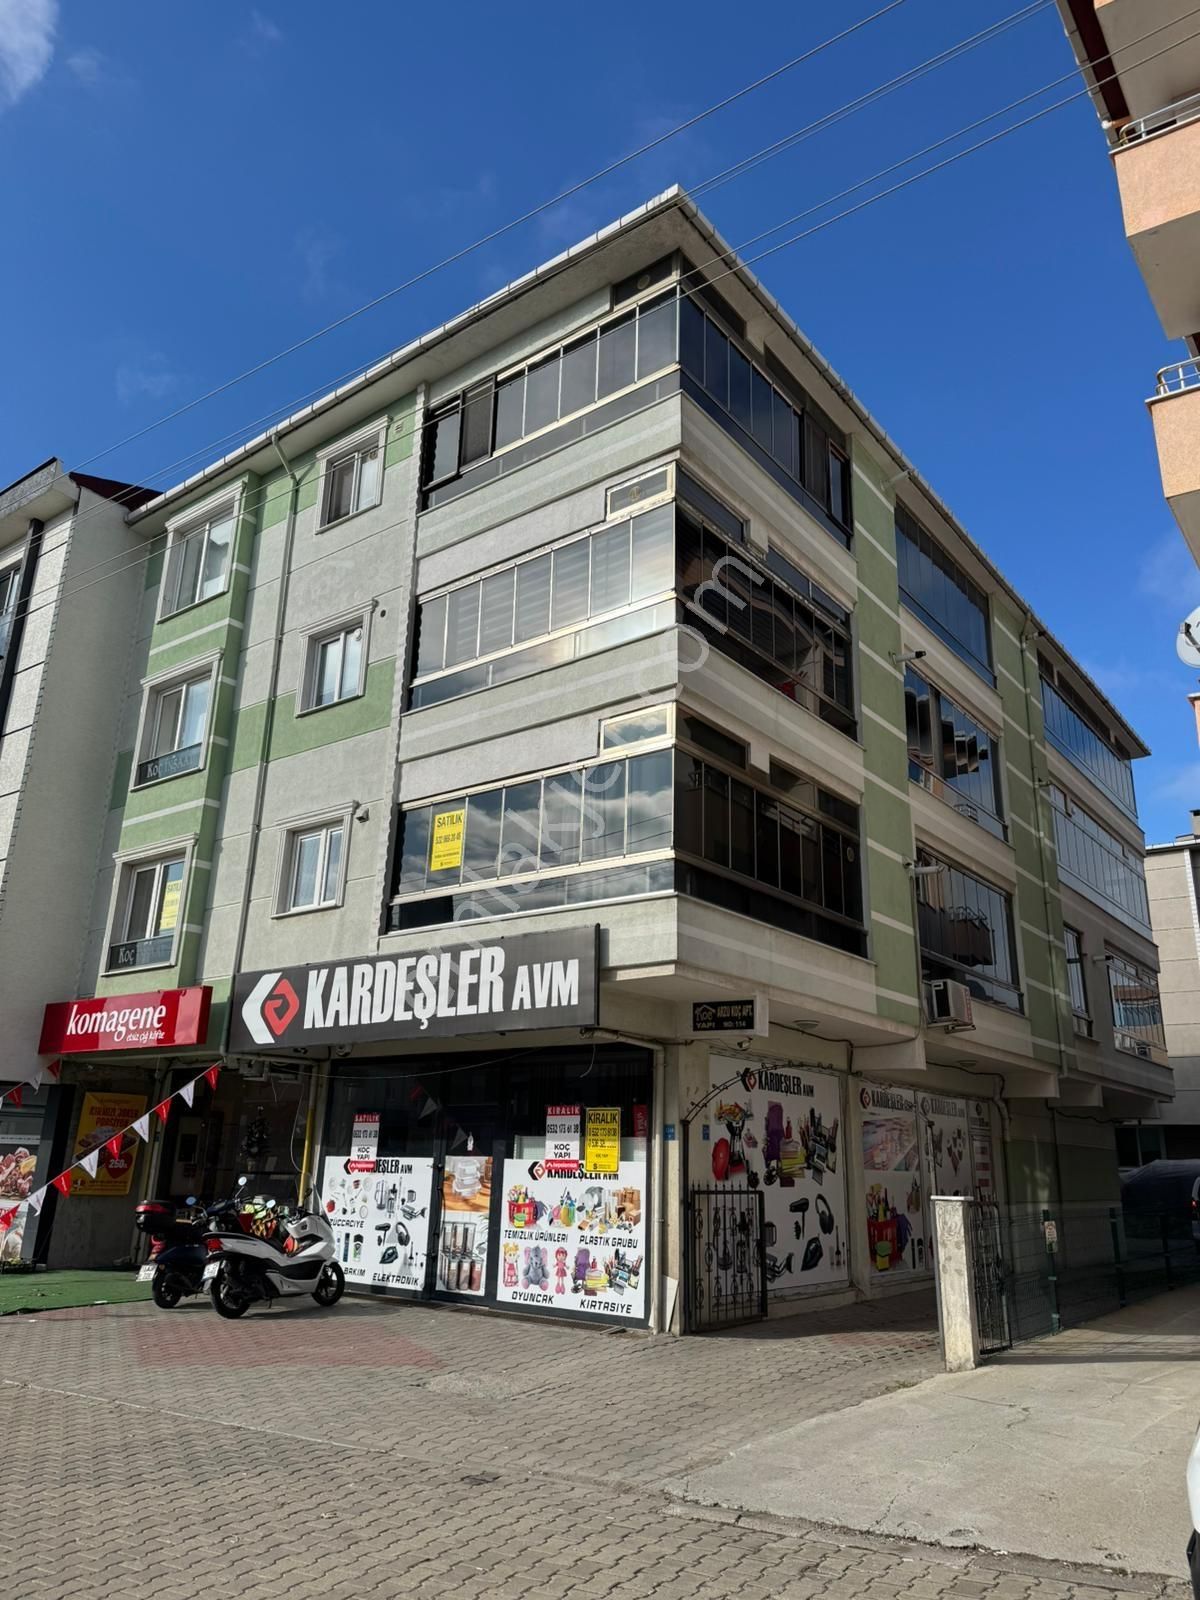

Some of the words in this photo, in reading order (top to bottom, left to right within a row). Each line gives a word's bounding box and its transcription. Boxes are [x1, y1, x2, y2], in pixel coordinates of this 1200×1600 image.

[437, 813, 463, 828] SATILIK
[303, 946, 505, 1030] KARDEŞLER
[511, 958, 580, 1011] AVM
[66, 1004, 167, 1042] komagene
[758, 1070, 802, 1097] KARDEŞLER
[802, 1084, 815, 1098] AVM
[554, 1143, 570, 1152] KOÇ
[400, 1164, 413, 1174] AVM
[611, 1237, 639, 1249] GRUBU
[343, 1267, 366, 1277] BAKIM
[511, 1291, 555, 1305] OYUNCAK
